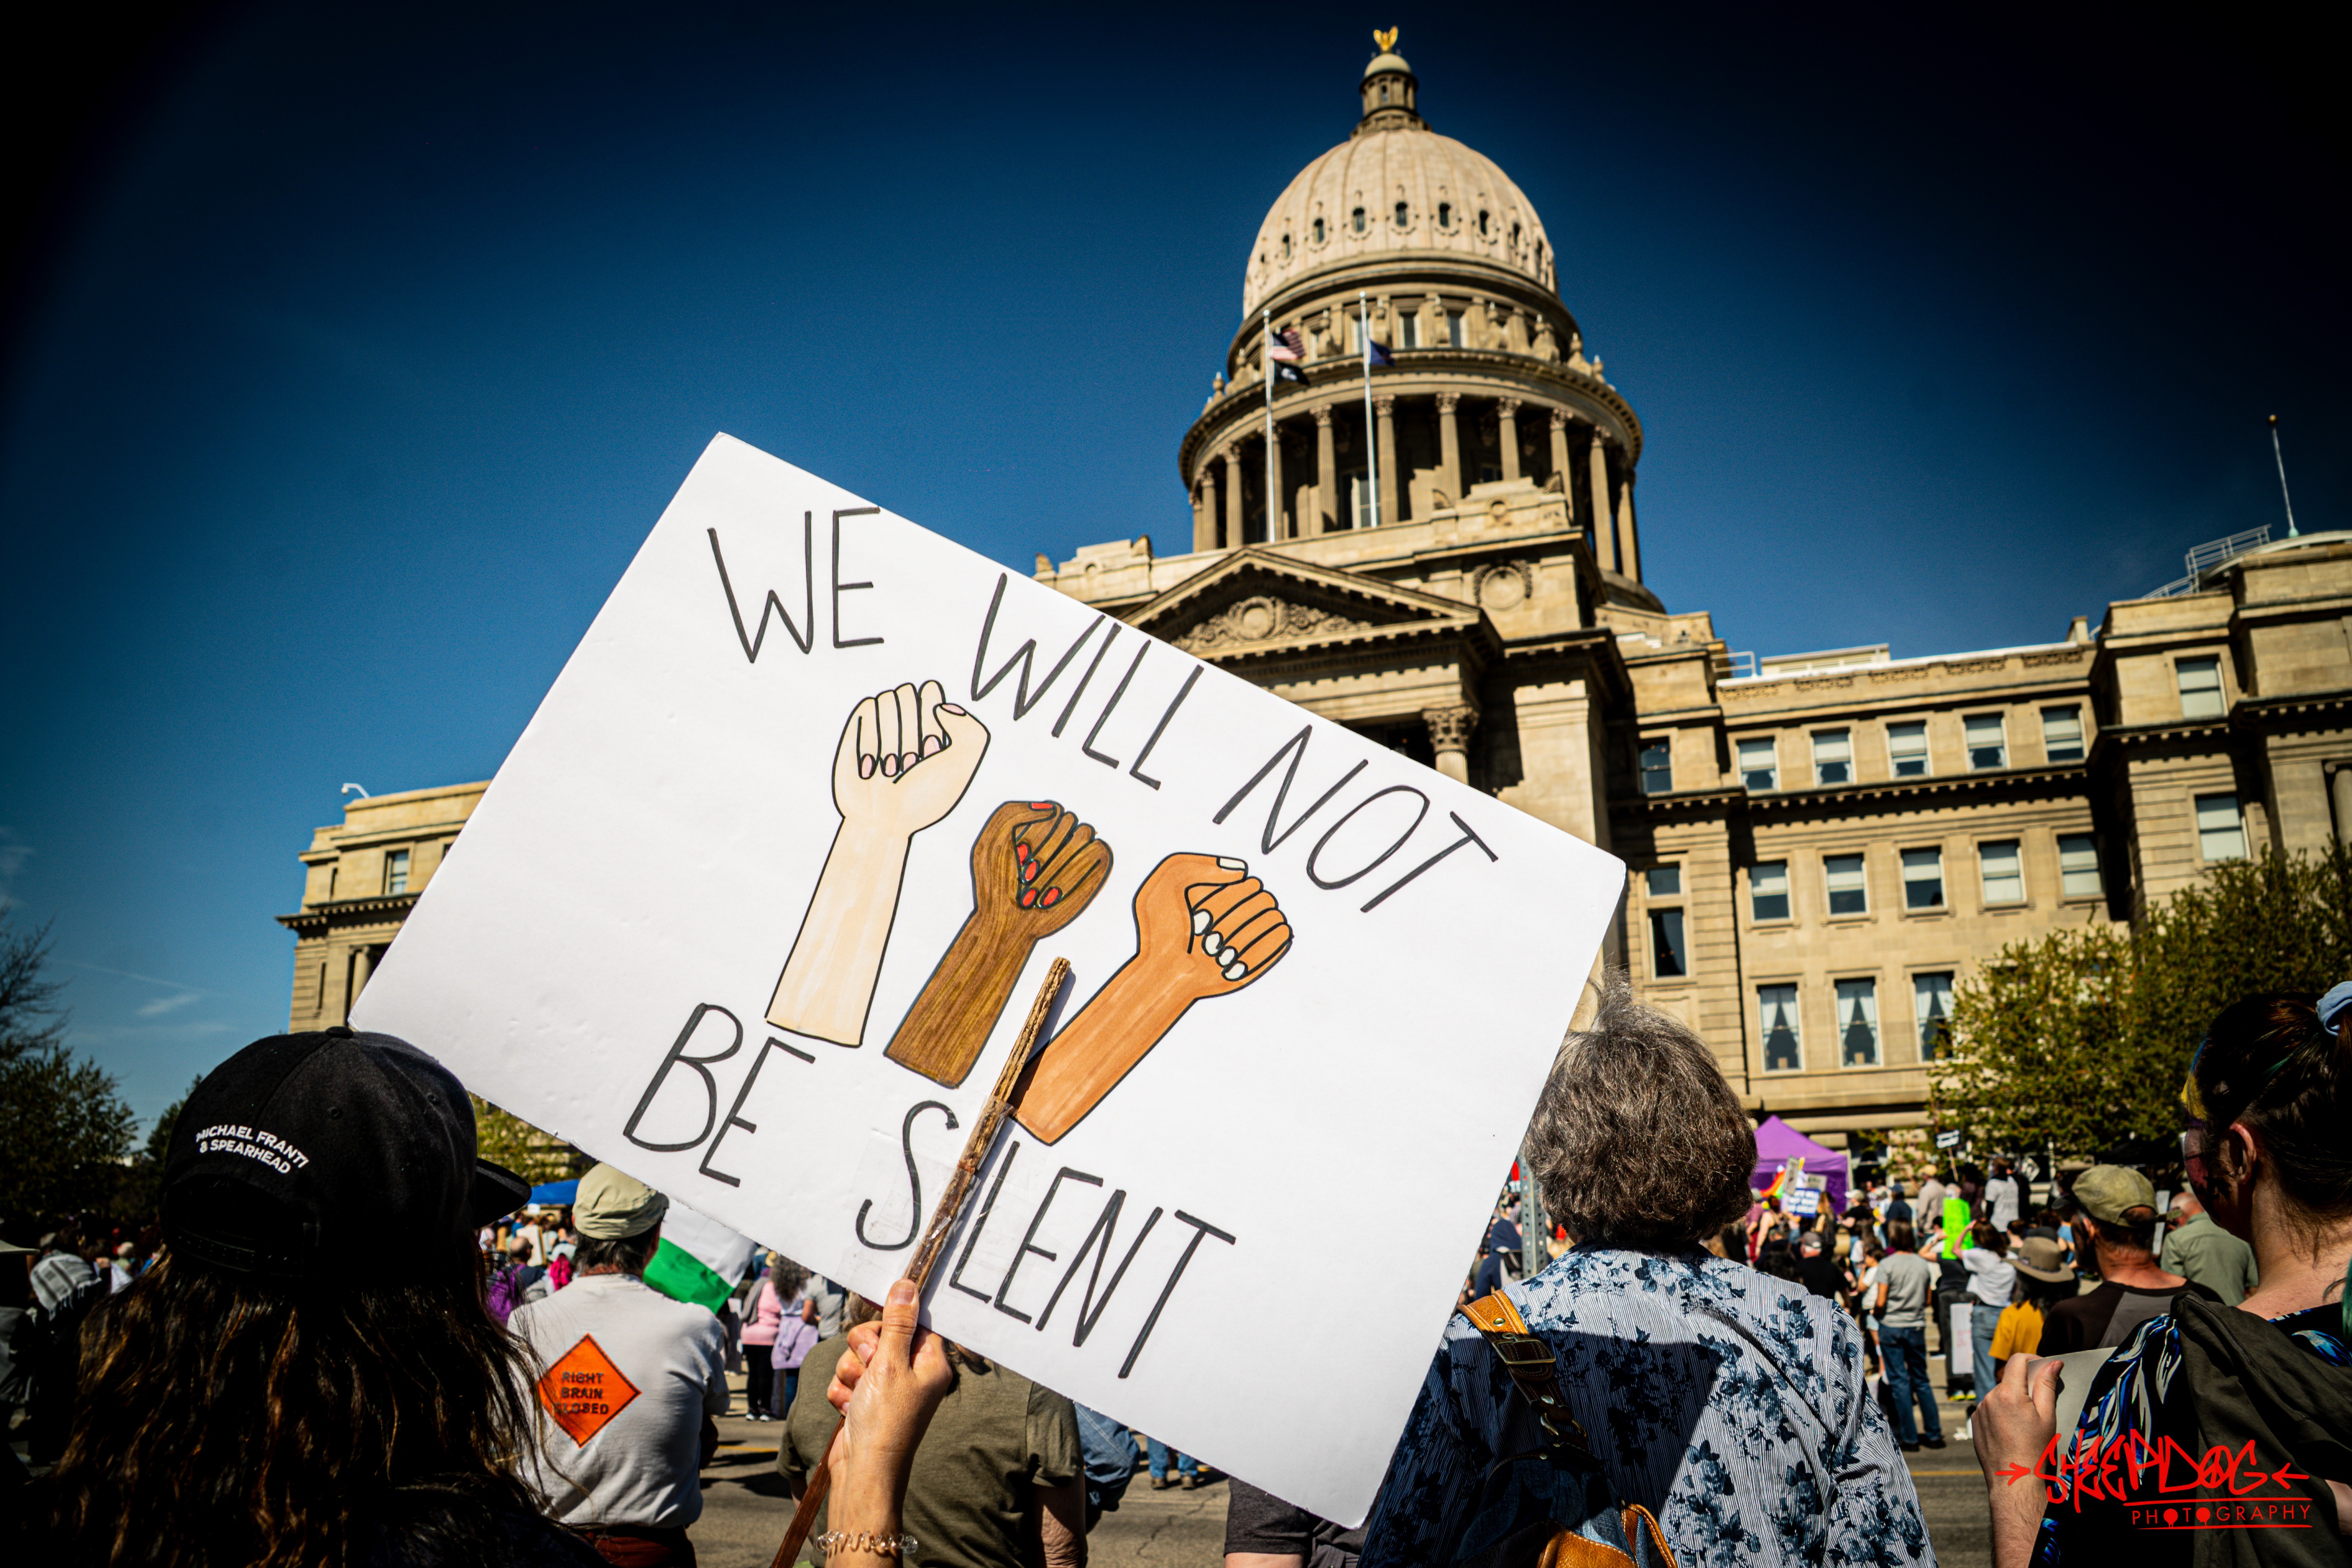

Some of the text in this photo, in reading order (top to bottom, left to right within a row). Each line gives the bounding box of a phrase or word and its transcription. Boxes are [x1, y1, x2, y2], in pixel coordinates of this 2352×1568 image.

[707, 507, 1499, 914] WE WILL NOT
[196, 1124, 309, 1168] MICHAEL FRANTI
[199, 1139, 291, 1174] & SPEARHEAD
[622, 1002, 1236, 1379] BE SLENT
[561, 1387, 603, 1399] BRAIN
[562, 1371, 604, 1384] RIGHT
